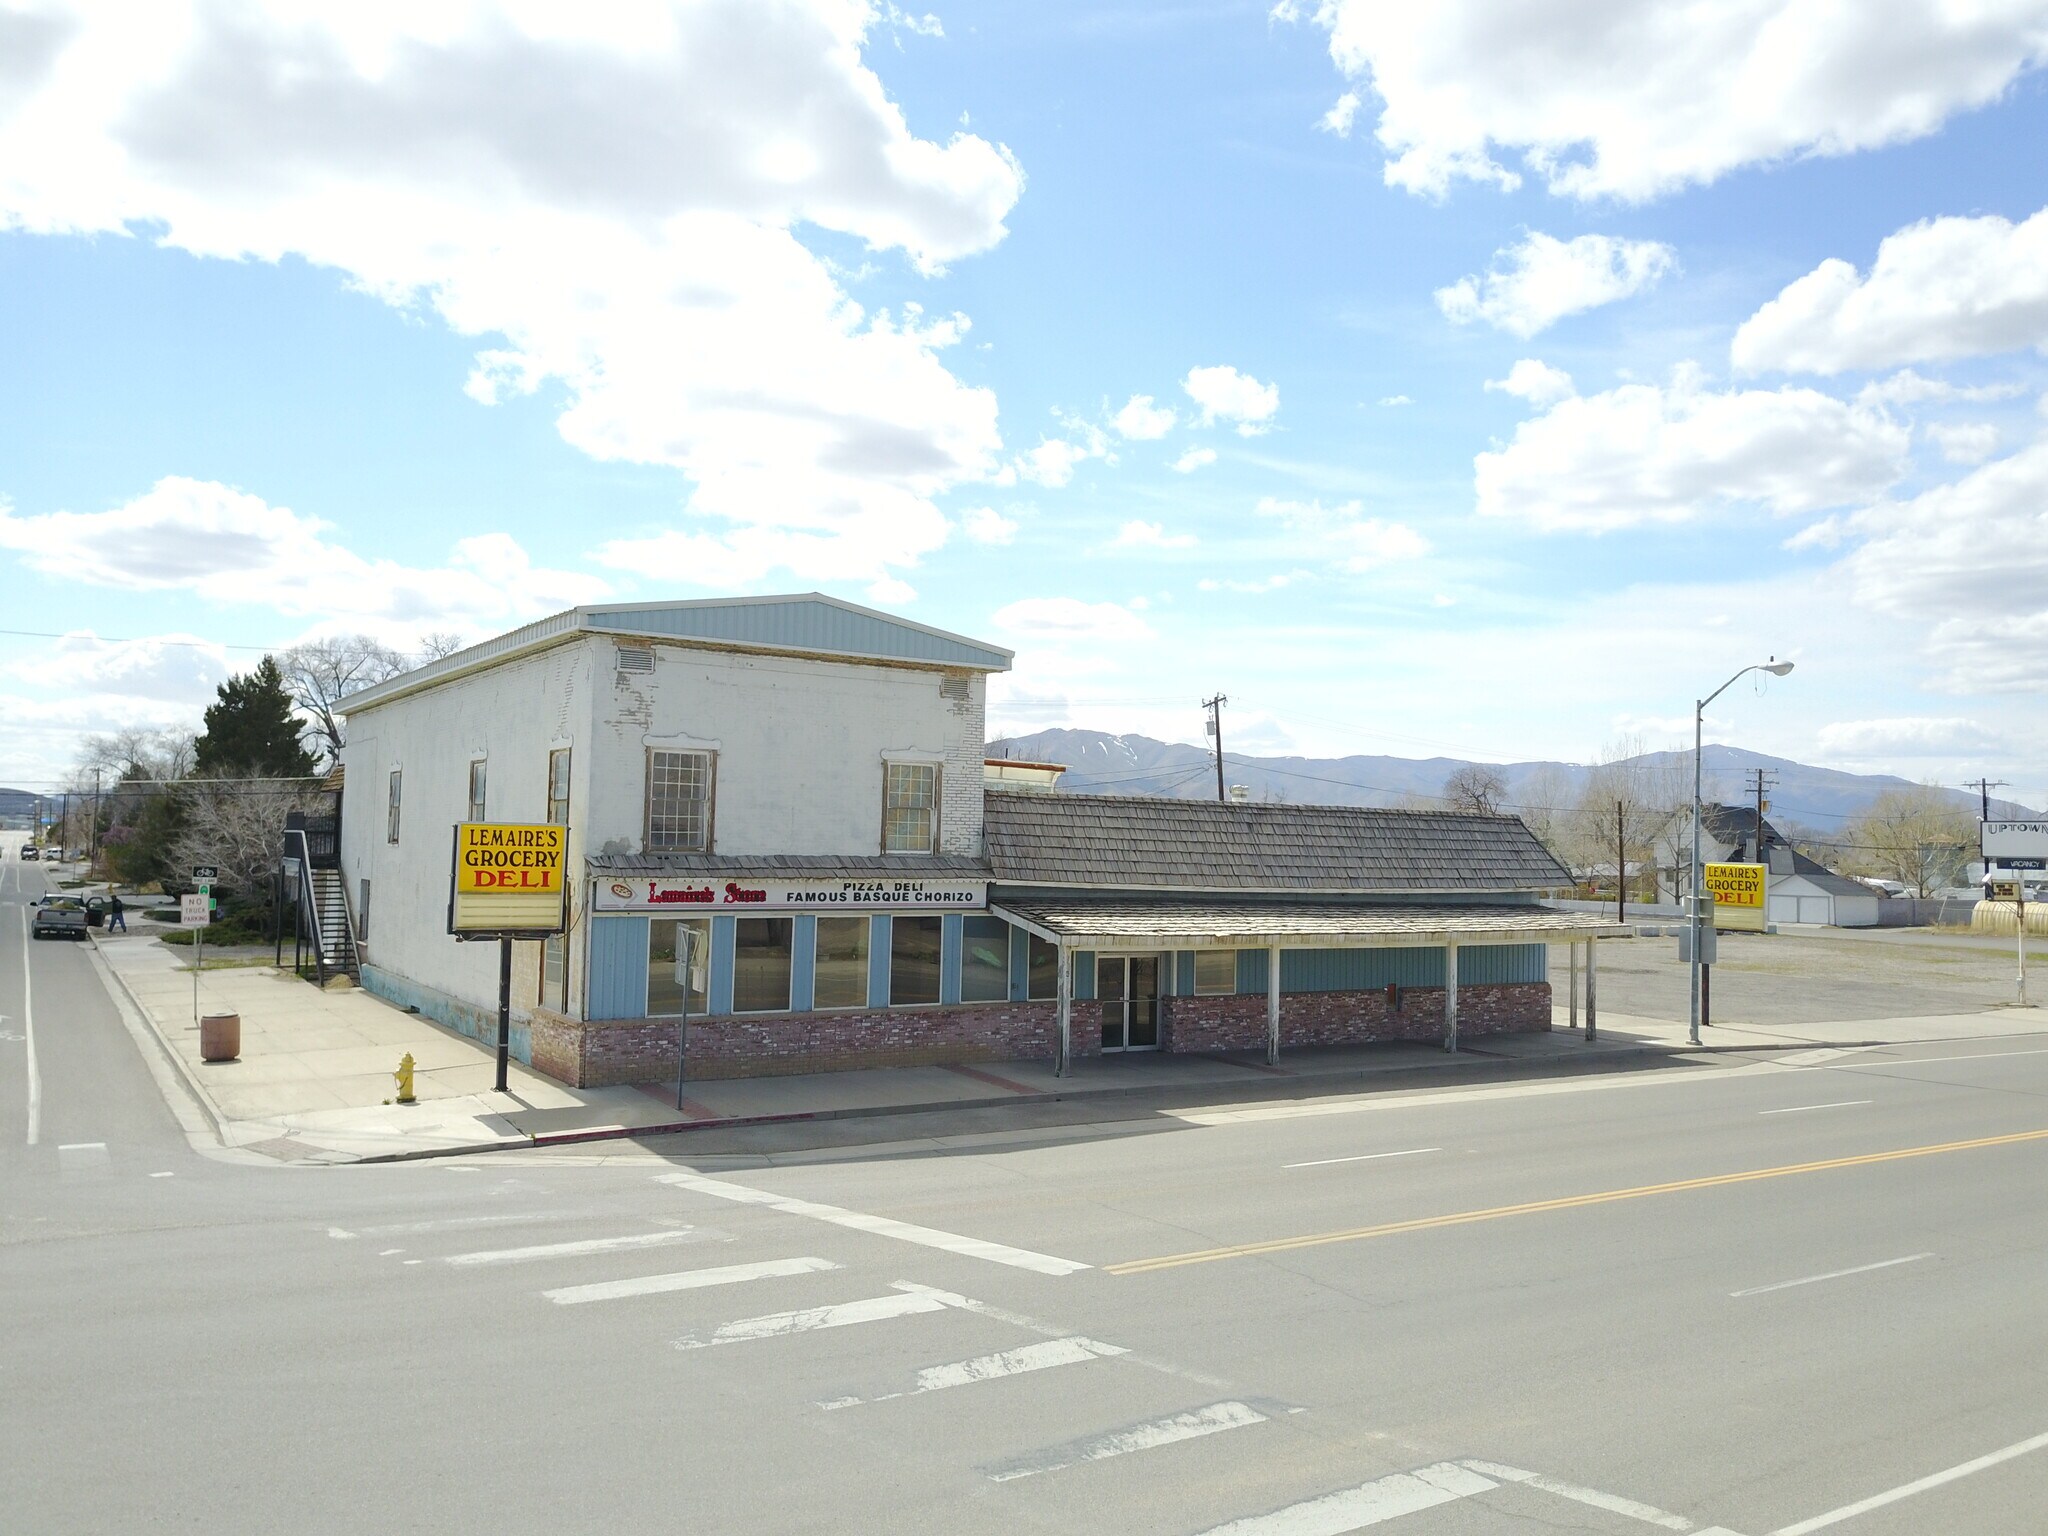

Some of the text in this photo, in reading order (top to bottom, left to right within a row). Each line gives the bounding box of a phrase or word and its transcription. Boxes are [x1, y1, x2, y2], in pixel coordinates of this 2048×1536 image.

[469, 829, 558, 847] LEMAIRE'S
[465, 849, 560, 867] GROCERY
[473, 870, 551, 888] DELI
[1708, 867, 1758, 879] LEMAIRE'S
[843, 882, 924, 892] PIZZA DELI
[1706, 879, 1759, 892] GROCERY
[786, 892, 974, 902] FAMOUS BASQUE CHORIZO
[1713, 892, 1755, 905] DELI
